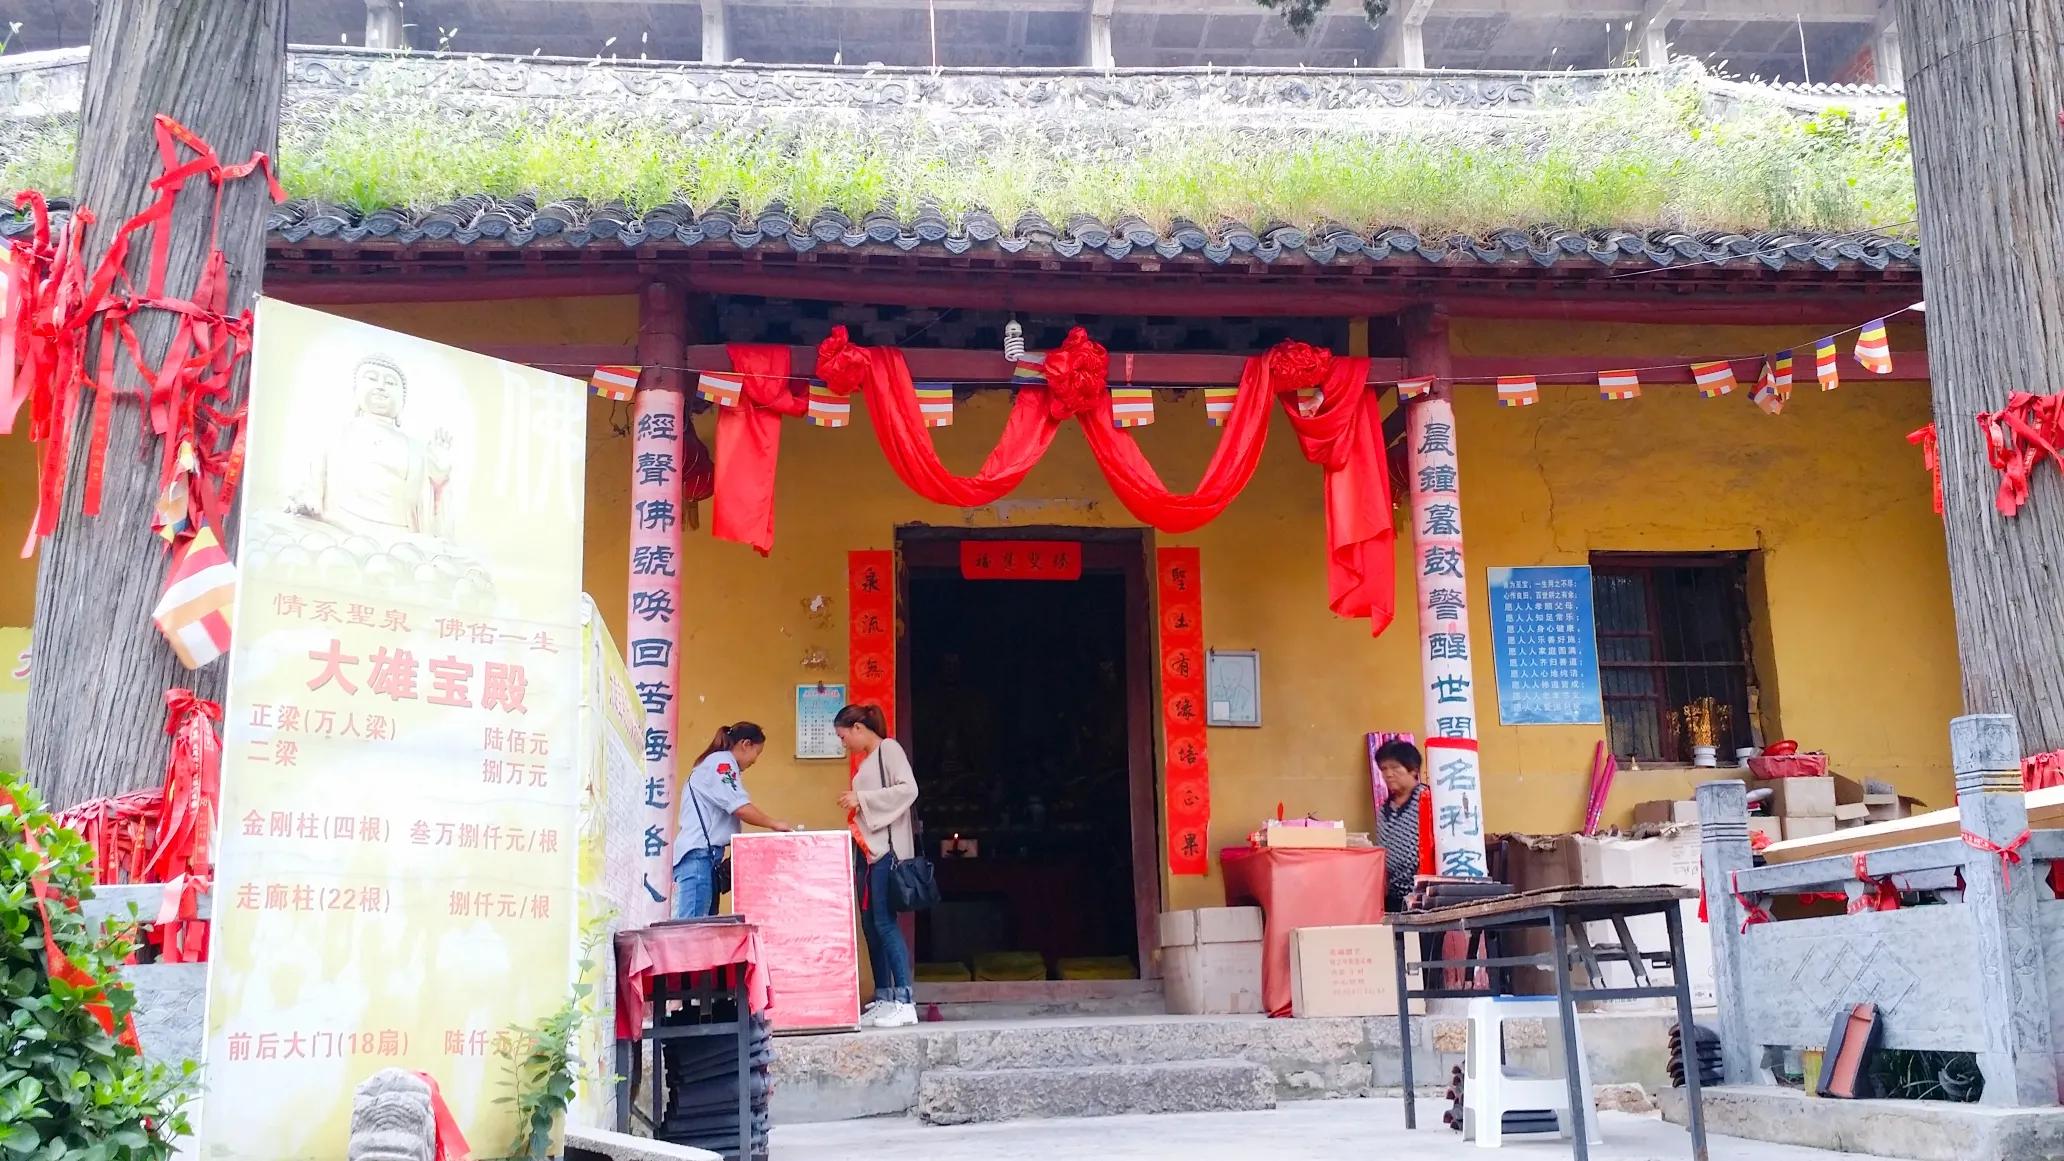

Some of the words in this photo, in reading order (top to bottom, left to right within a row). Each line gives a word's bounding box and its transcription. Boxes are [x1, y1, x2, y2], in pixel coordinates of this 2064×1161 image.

[273, 593, 412, 634] 情系聖泉
[435, 617, 560, 655] 佛佑一生
[306, 638, 529, 714] 大雄宝殿
[248, 703, 398, 742] 正梁(万人梁)
[483, 726, 550, 757] 陆佰元
[247, 740, 299, 767] 二梁
[482, 758, 549, 788] 捌万元
[242, 809, 391, 843] 金刚柱(四根)
[409, 819, 559, 853] 叁万捌仟元/根
[236, 882, 392, 913] 走廊柱(22根)
[448, 890, 551, 919] 捌仟元/根
[228, 1029, 410, 1061] 前后大门(18扇)
